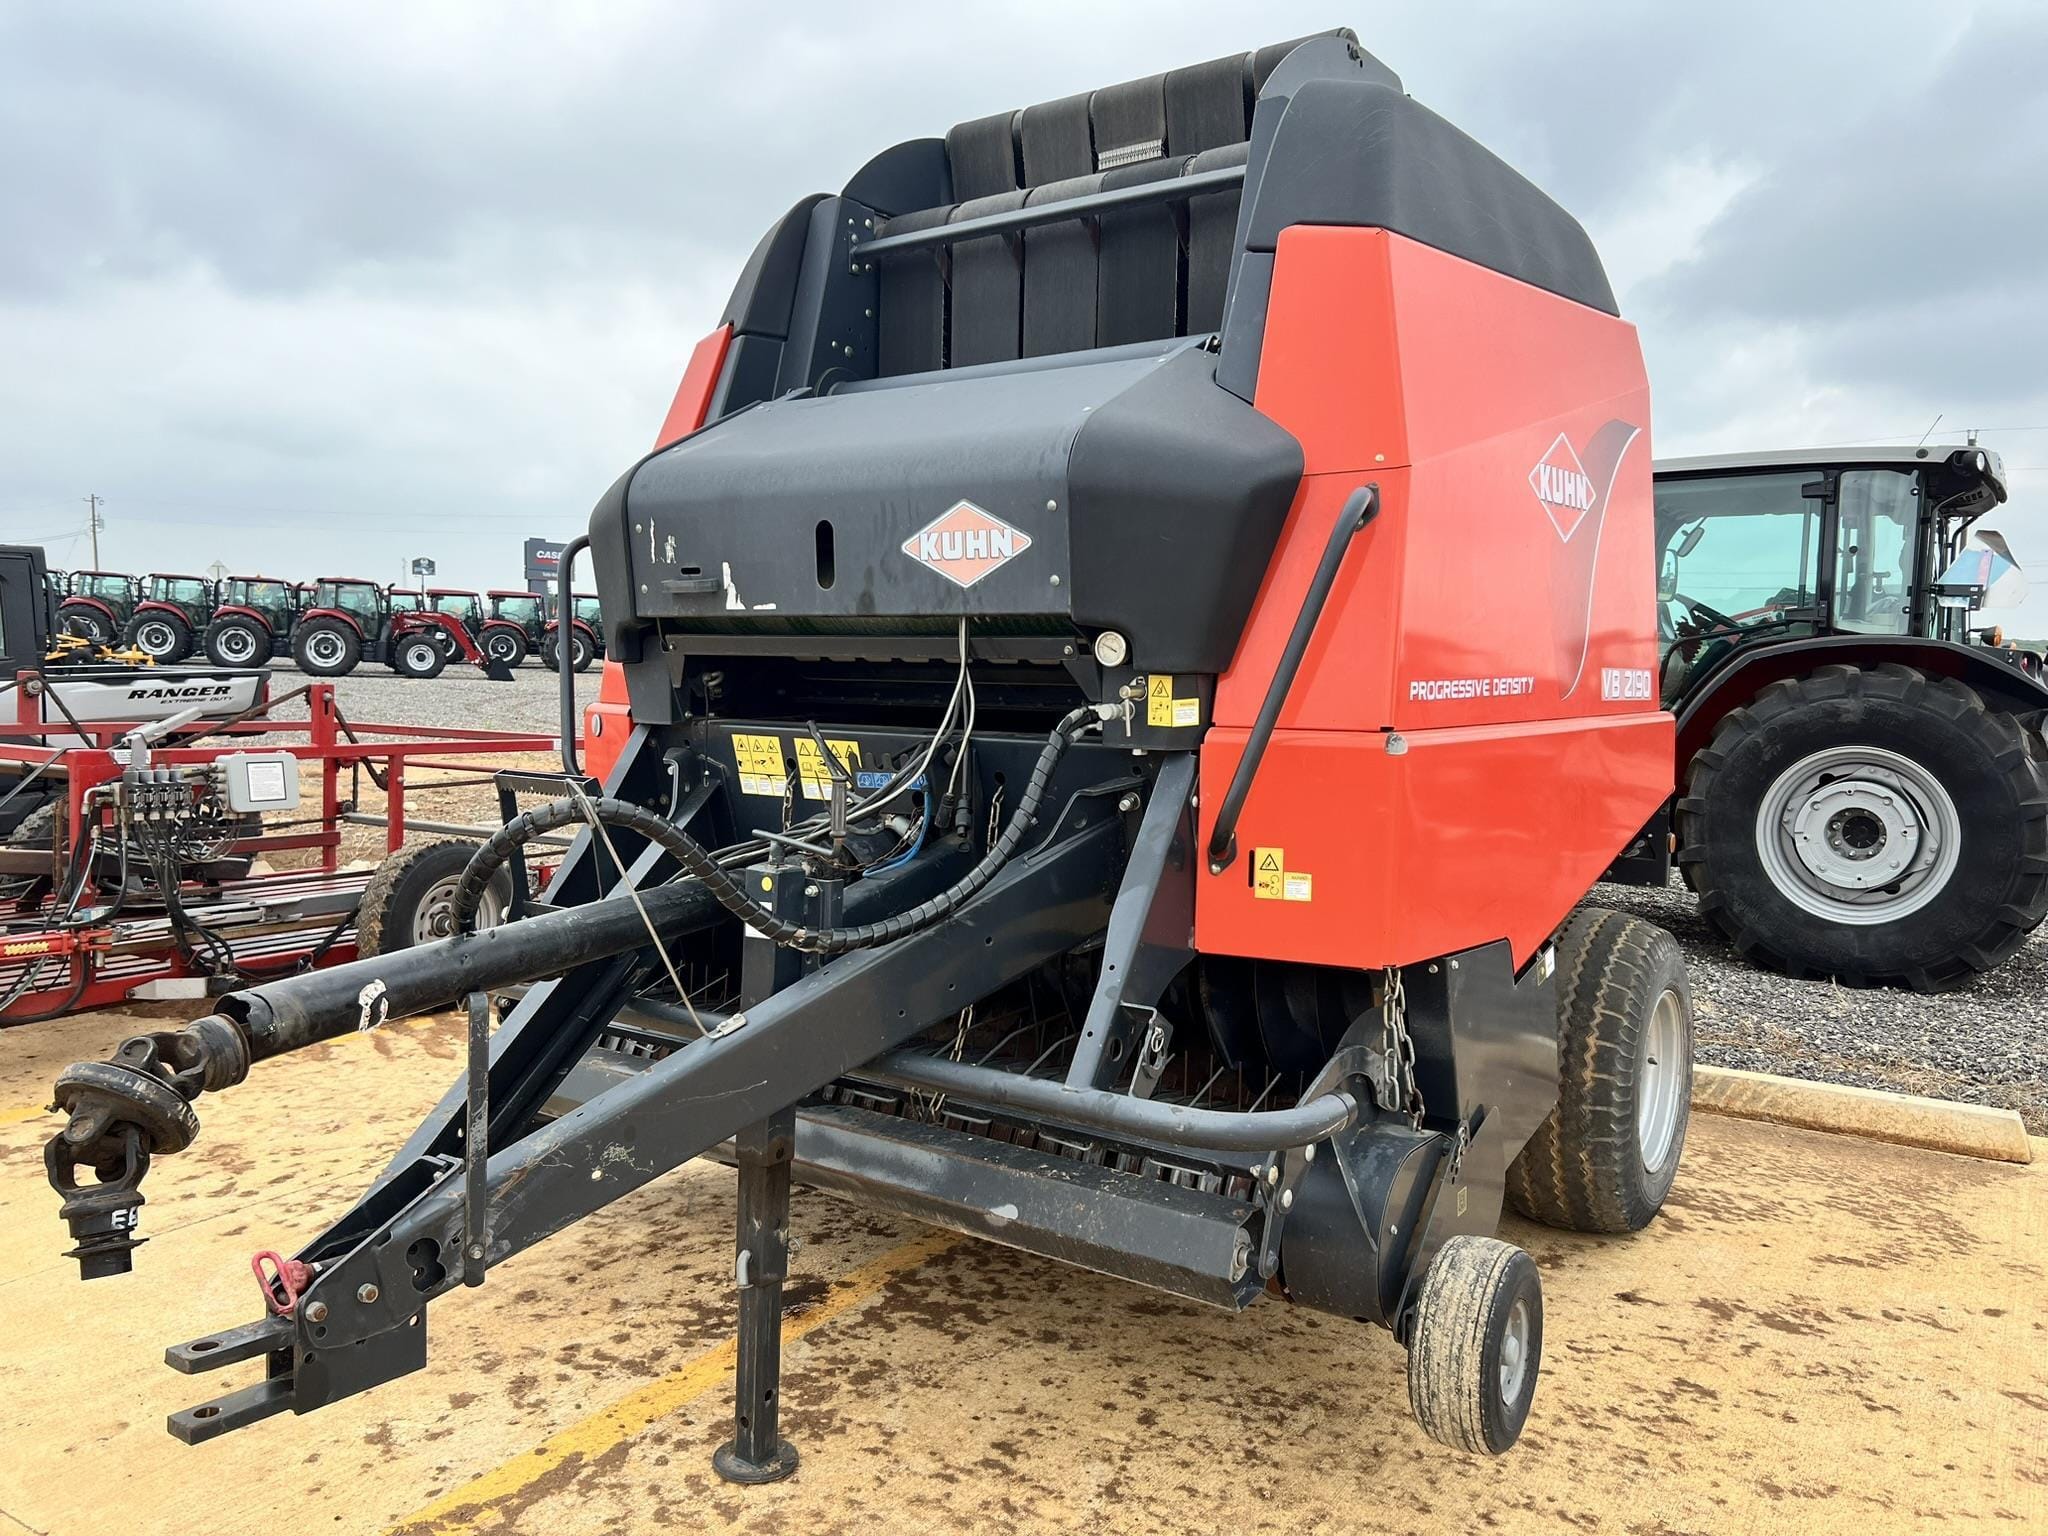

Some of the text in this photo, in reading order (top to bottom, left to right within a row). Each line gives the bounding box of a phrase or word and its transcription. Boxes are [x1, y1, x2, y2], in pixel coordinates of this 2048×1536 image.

[1540, 463, 1588, 511] KUHN
[920, 528, 1013, 561] KUHN
[128, 686, 231, 699] RANGER
[1409, 676, 1534, 700] PROGRESSIVE DENSITY
[1601, 669, 1651, 698] VB 2190
